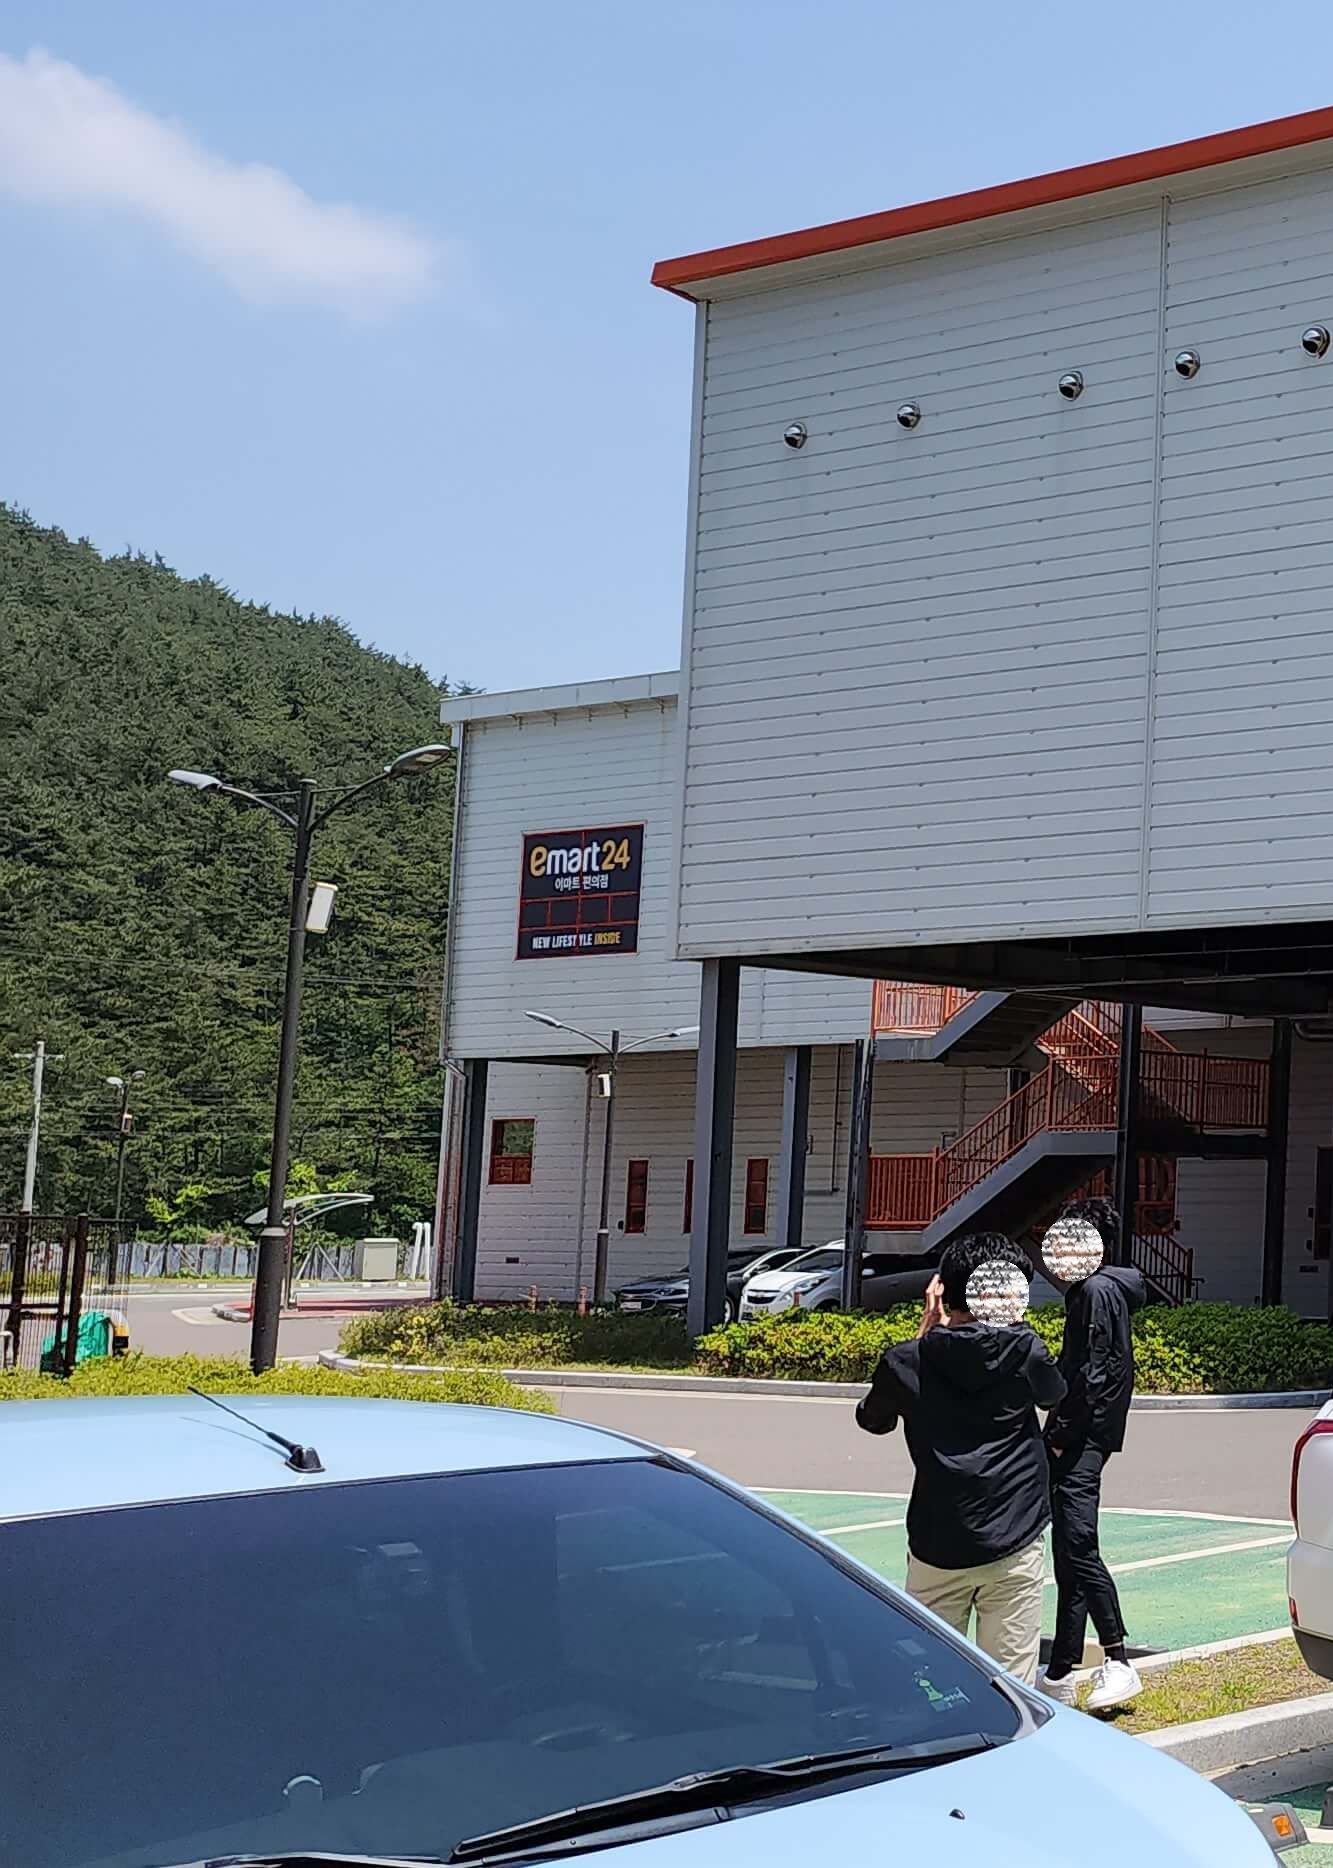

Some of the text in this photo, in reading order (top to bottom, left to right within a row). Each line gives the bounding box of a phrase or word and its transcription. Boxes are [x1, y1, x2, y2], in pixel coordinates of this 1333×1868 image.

[530, 838, 631, 877] emart24
[554, 874, 609, 892] 이마트 편의점
[532, 932, 621, 949] NEW LIFESTYLE INSIDE
